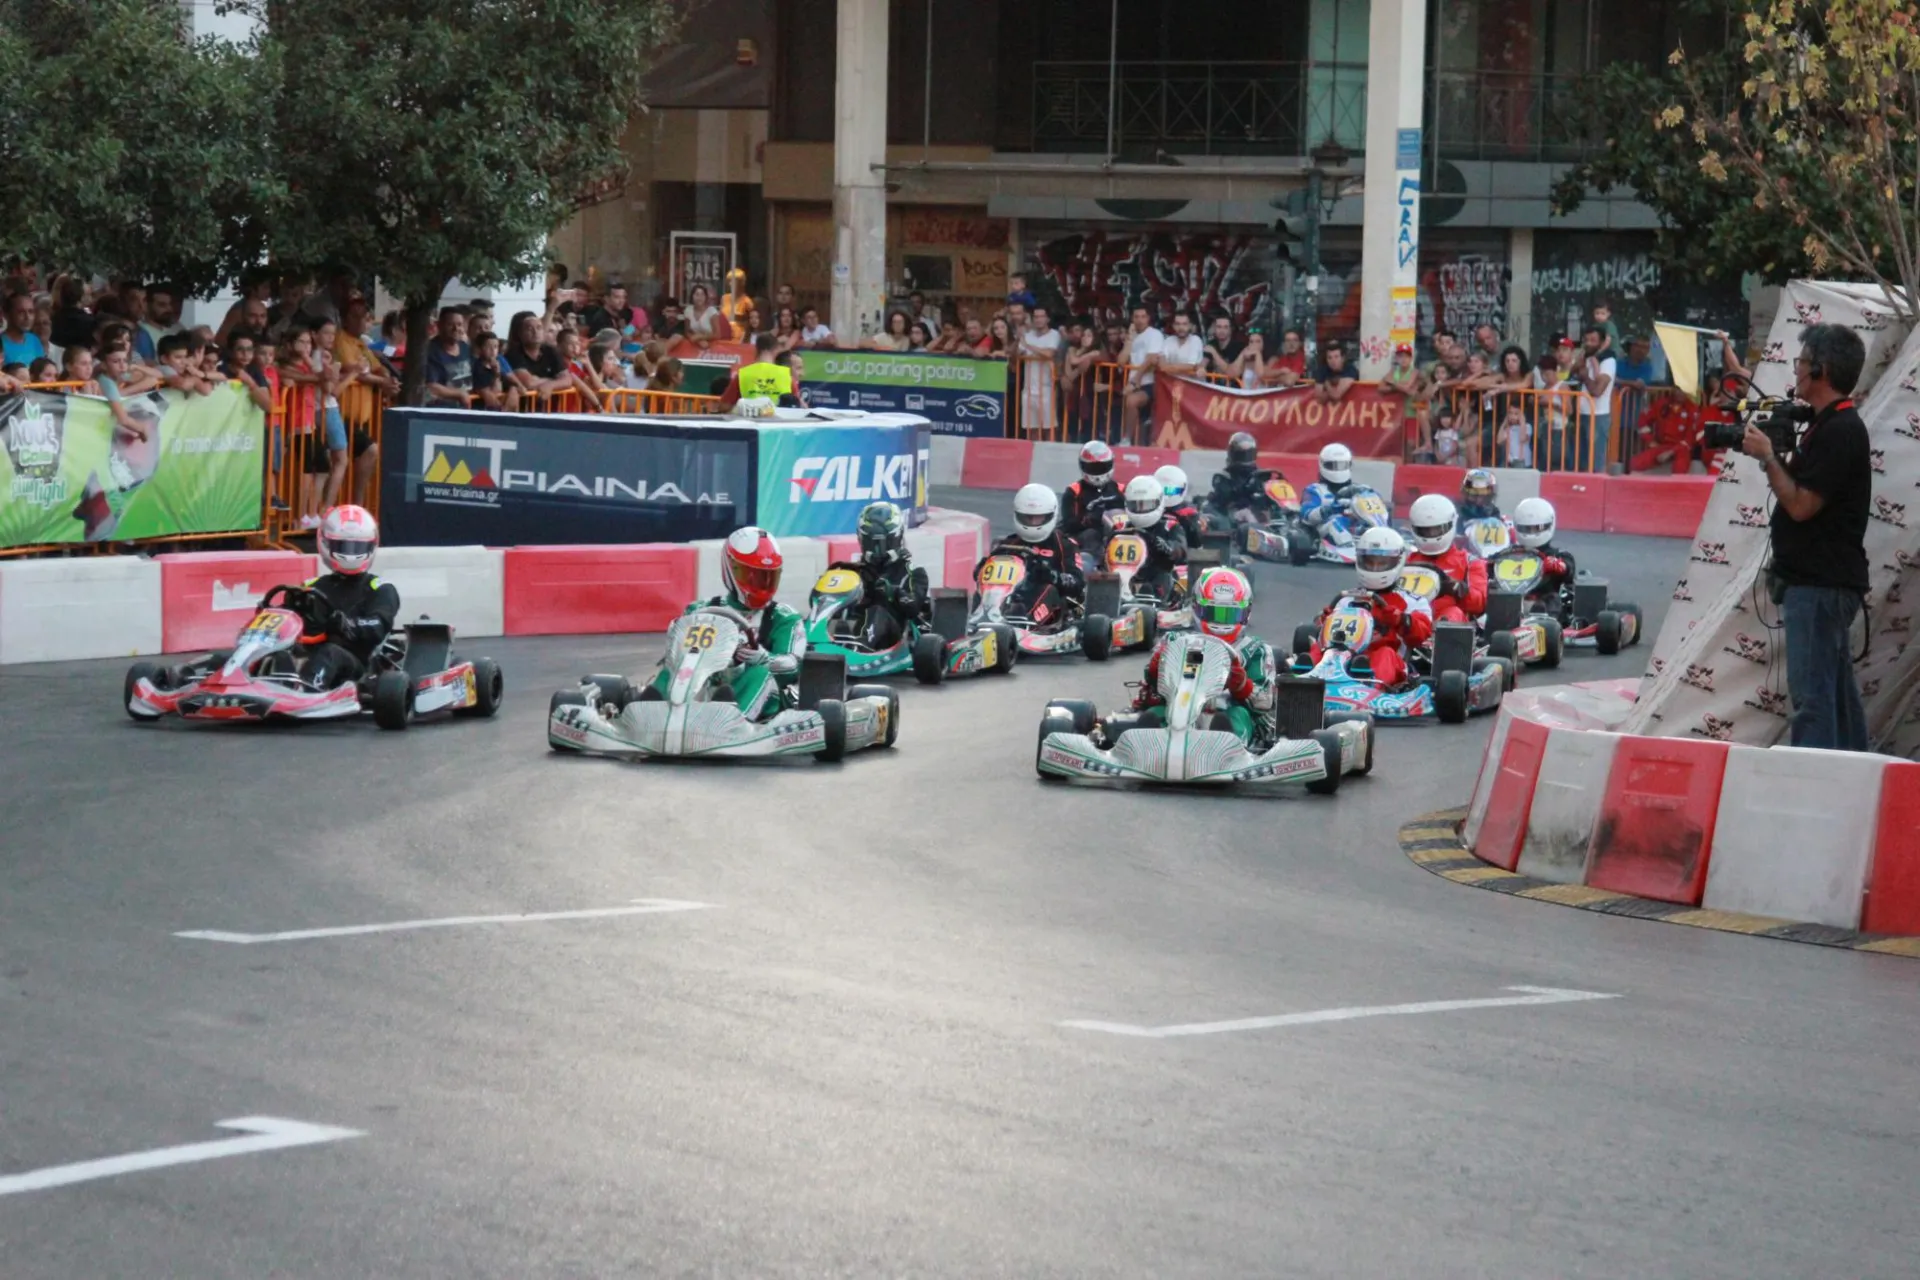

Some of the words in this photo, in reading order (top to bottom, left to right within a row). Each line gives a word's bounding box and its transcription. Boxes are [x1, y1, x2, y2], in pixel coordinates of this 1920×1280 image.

[685, 262, 720, 280] SALE
[824, 359, 860, 375] auto
[864, 360, 922, 381] parking
[925, 362, 976, 382] patras
[1204, 395, 1397, 430] ΜΠΟΥΛΟΥΛΗΣ
[423, 485, 499, 503] www.triaina.gr
[1481, 526, 1501, 542] 27
[1114, 544, 1136, 561] 46
[983, 565, 1015, 581] 911
[1512, 564, 1523, 578] 4
[827, 576, 840, 587] 5
[256, 613, 284, 628] 19
[1331, 618, 1358, 637] 24
[685, 626, 716, 650] 56
